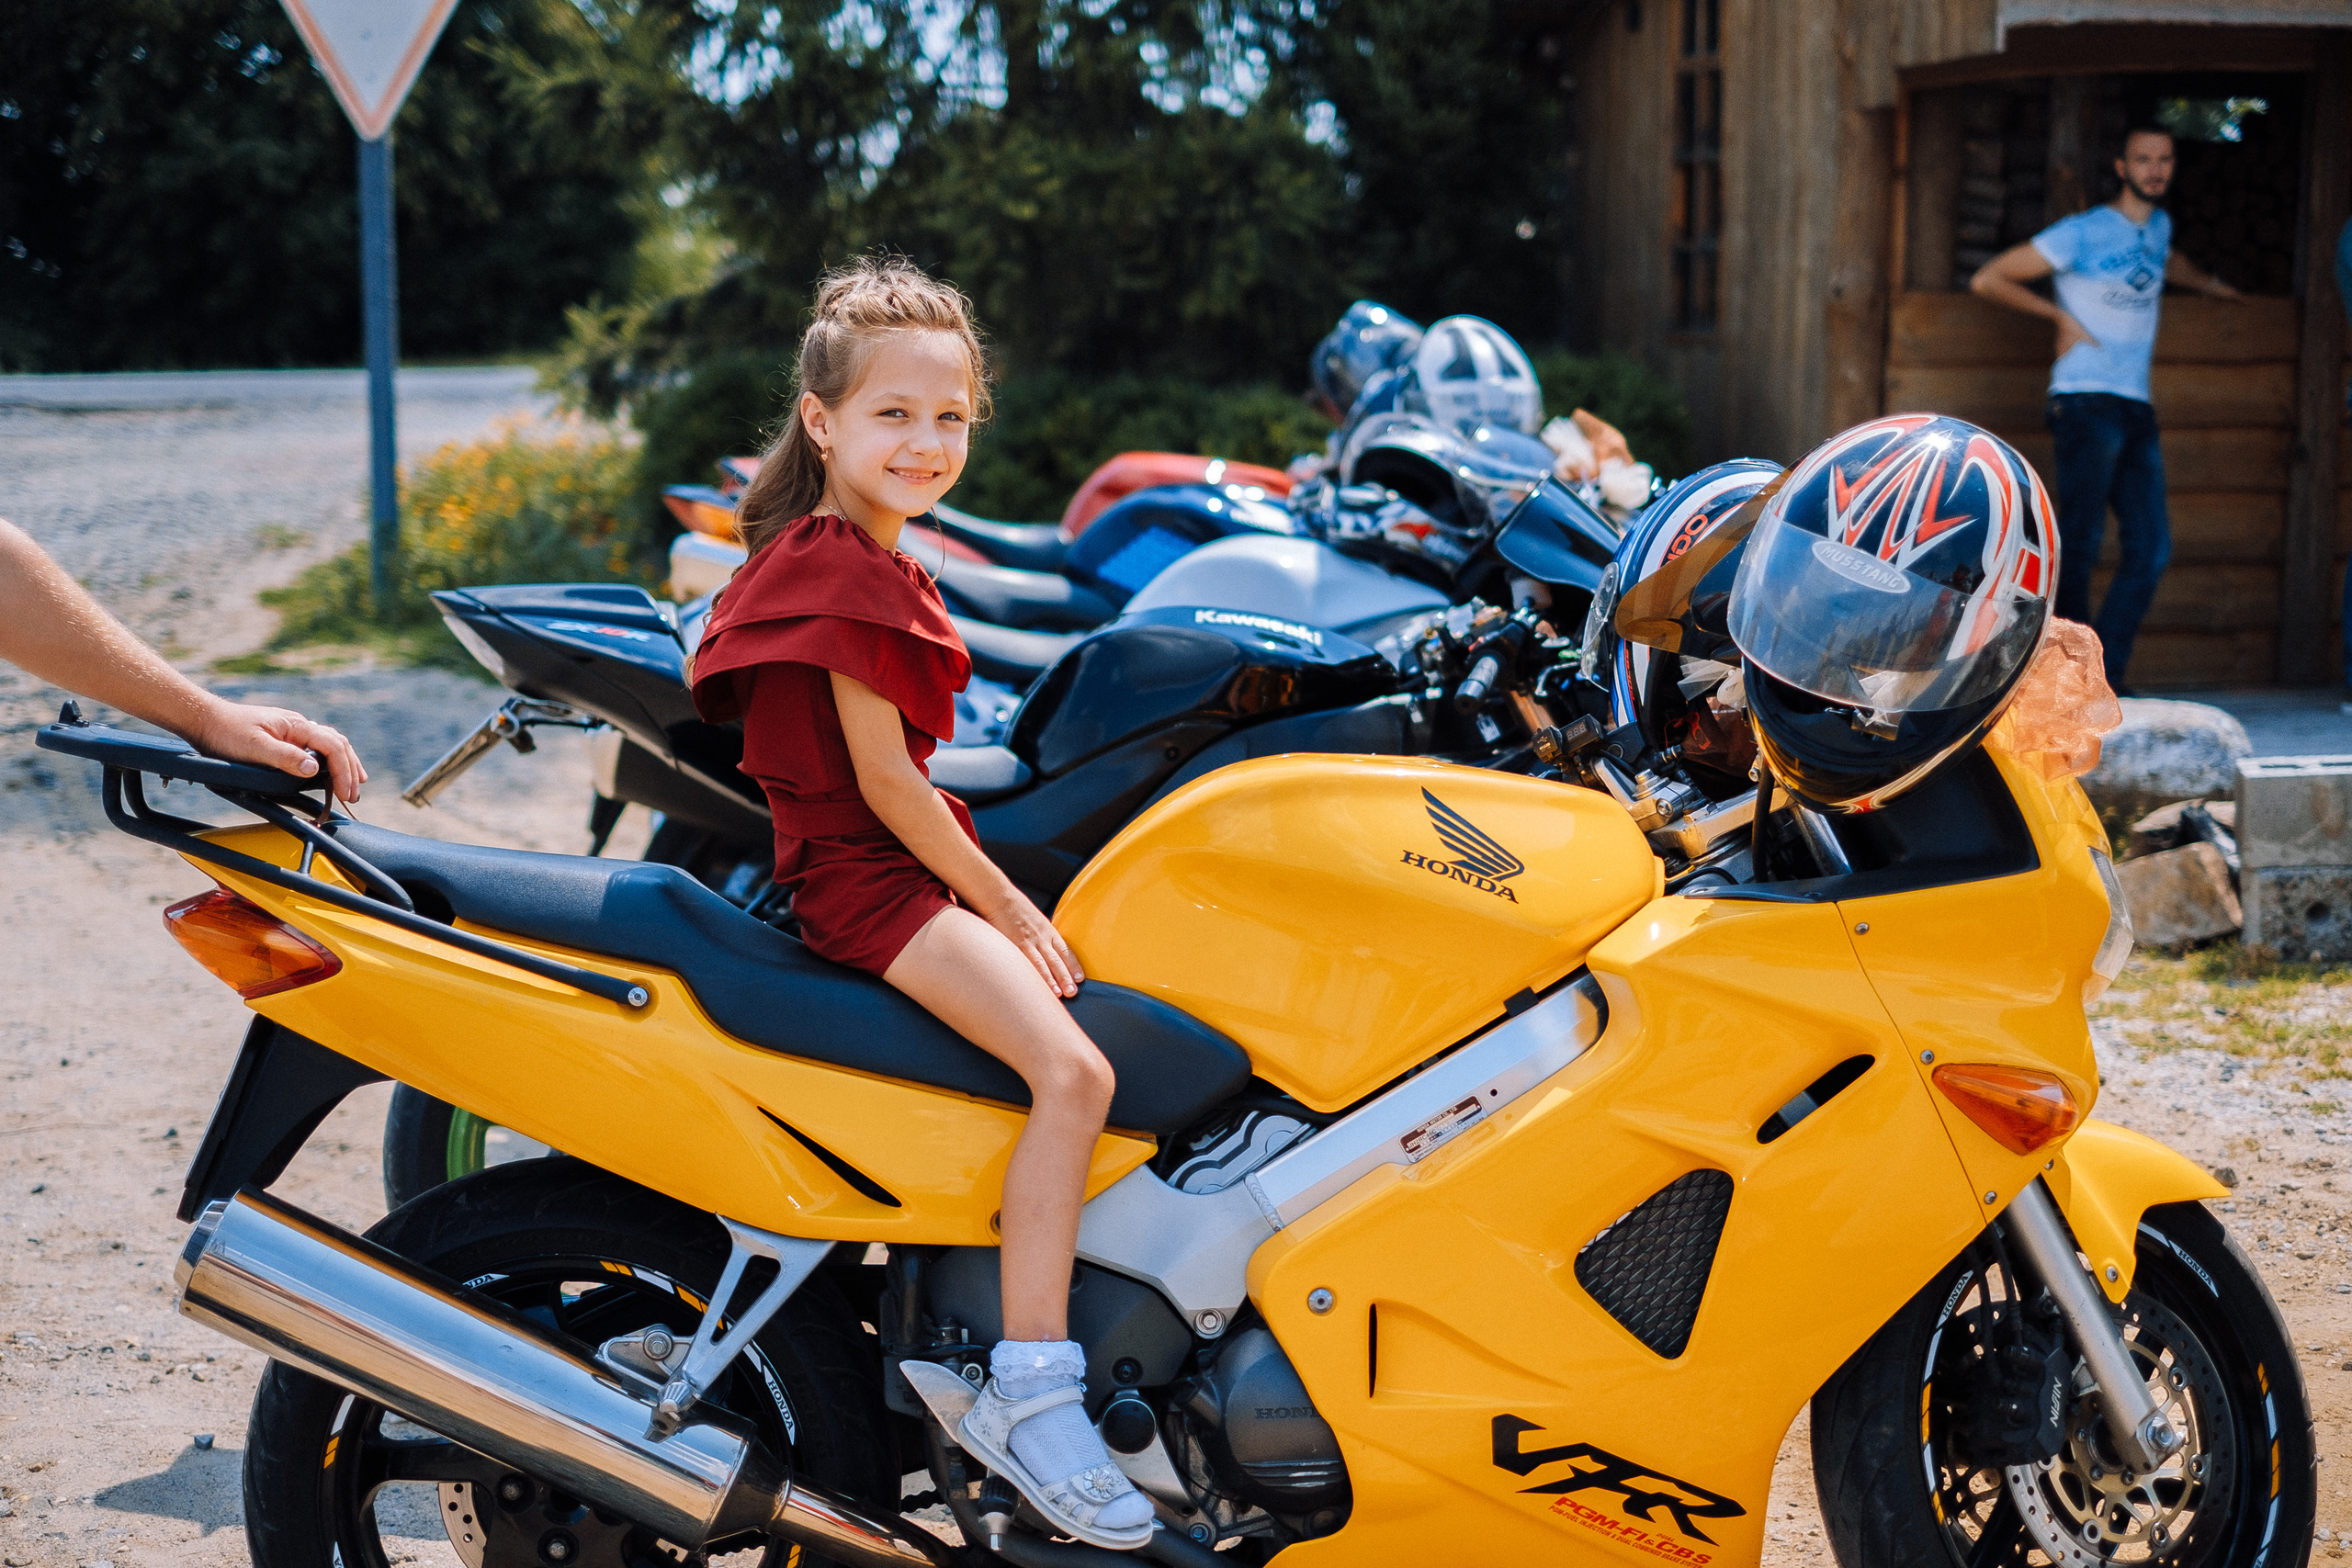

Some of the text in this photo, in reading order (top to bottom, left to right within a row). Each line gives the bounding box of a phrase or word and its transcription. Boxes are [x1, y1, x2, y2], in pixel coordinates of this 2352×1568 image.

[1820, 546, 1901, 588] MUSSTANG
[1194, 610, 1323, 646] Kawasaki
[1400, 850, 1519, 904] HONDA
[2178, 1249, 2211, 1286] HONDA
[1941, 1276, 1969, 1317] HONDA
[768, 1380, 793, 1429] HONDA
[1491, 1413, 1747, 1547] VFR
